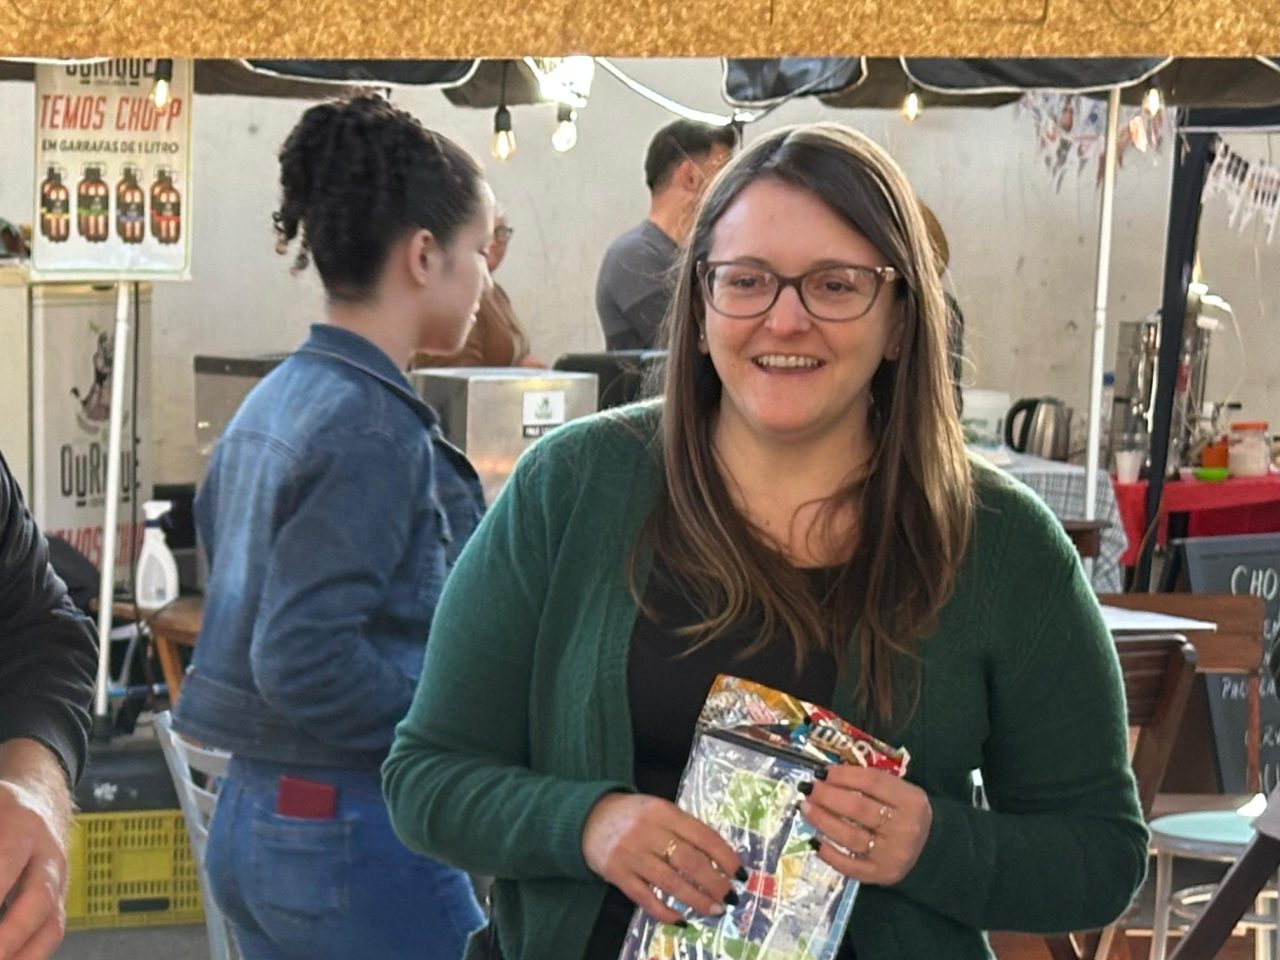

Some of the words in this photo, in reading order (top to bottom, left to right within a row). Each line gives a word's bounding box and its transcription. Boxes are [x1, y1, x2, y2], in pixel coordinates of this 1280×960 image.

[40, 94, 107, 130] TEMOS
[42, 139, 57, 152] EM
[60, 140, 118, 153] GARRAFAS
[120, 141, 135, 153] DE
[144, 142, 180, 154] LITRO
